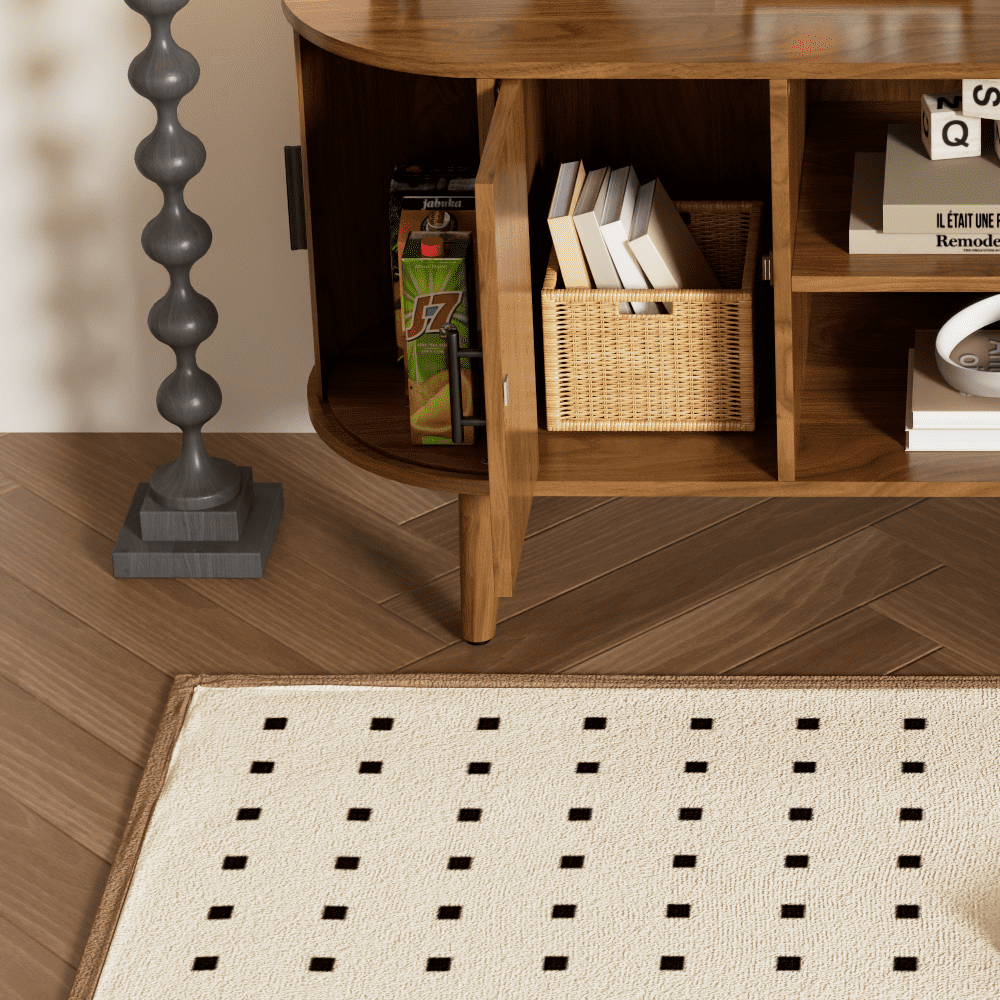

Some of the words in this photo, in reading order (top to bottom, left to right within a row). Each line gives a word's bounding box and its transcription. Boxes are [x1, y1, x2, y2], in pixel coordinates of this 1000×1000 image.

[941, 119, 970, 148] Q
[420, 198, 463, 210] jabuka
[936, 211, 945, 228] IL
[947, 208, 973, 228] ÉTAIT
[975, 212, 994, 228] UNE
